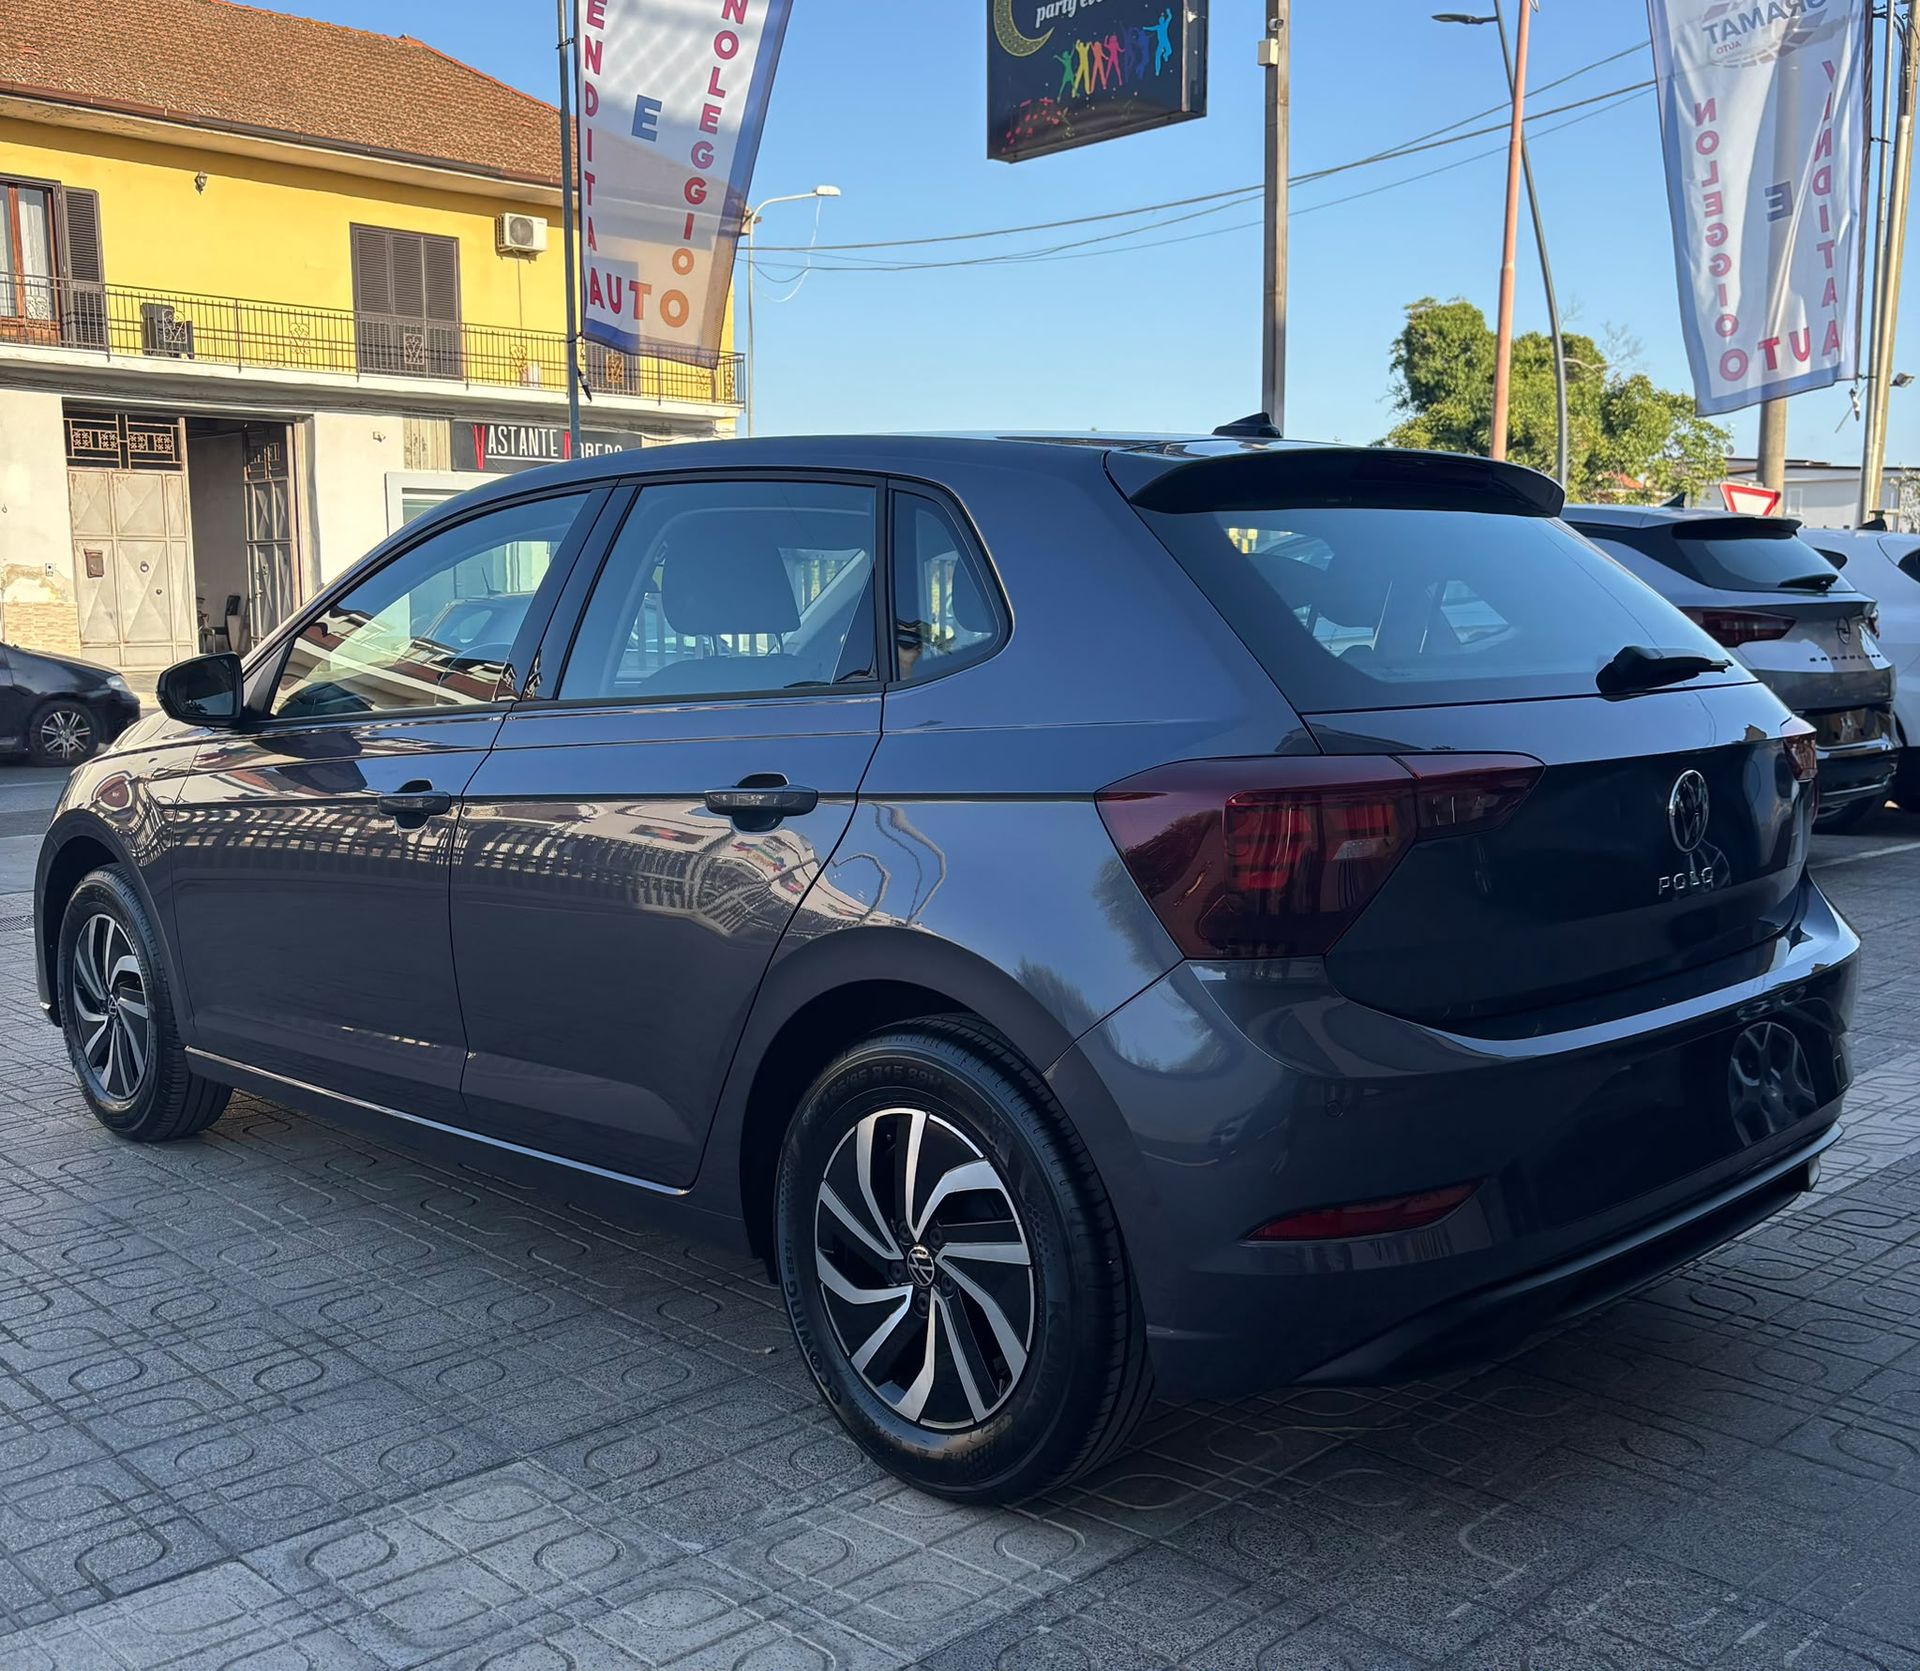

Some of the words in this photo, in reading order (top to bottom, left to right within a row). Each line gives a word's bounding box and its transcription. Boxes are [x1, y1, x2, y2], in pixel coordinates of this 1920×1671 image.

[1035, 0, 1077, 28] party
[632, 94, 663, 142] E
[589, 267, 690, 329] AUTO
[472, 424, 559, 470] VASTANTE
[1658, 865, 1714, 896] POLO
